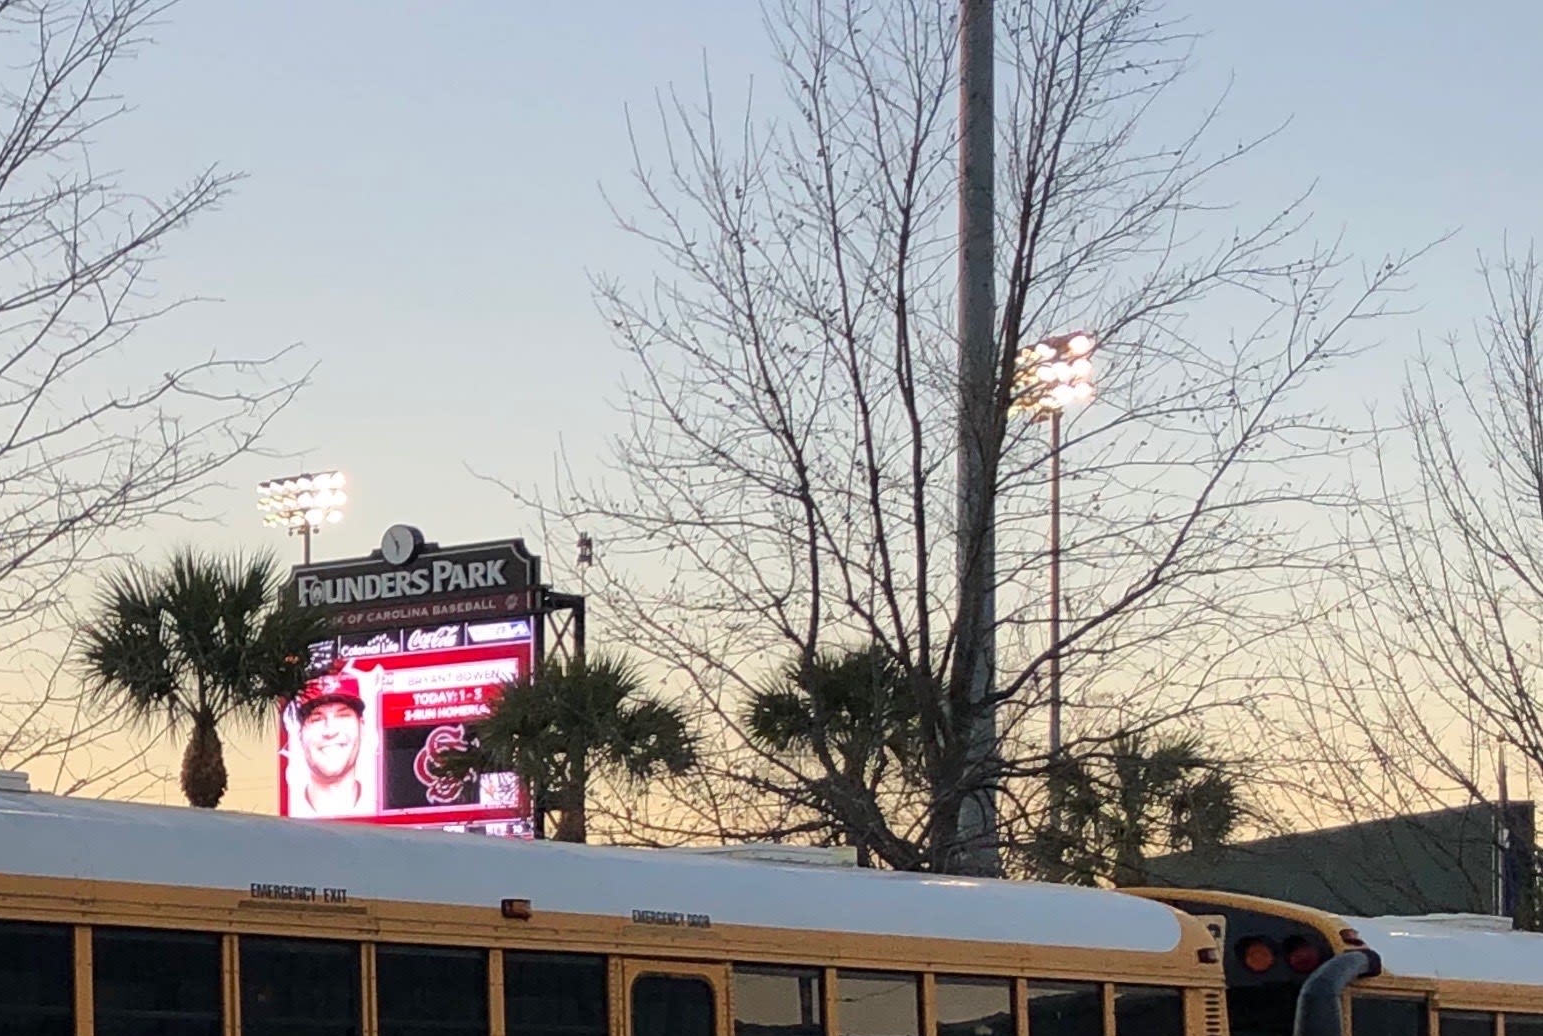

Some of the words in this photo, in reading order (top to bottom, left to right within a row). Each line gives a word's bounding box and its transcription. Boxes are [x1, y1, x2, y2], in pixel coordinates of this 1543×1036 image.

[297, 568, 431, 608] FOUNDERS
[432, 559, 508, 593] PARK
[347, 615, 363, 625] OF
[366, 608, 429, 623] CAROLINA
[432, 599, 497, 615] BASEBALL
[250, 883, 316, 902] EMERGENCY
[323, 888, 347, 903] EXIT
